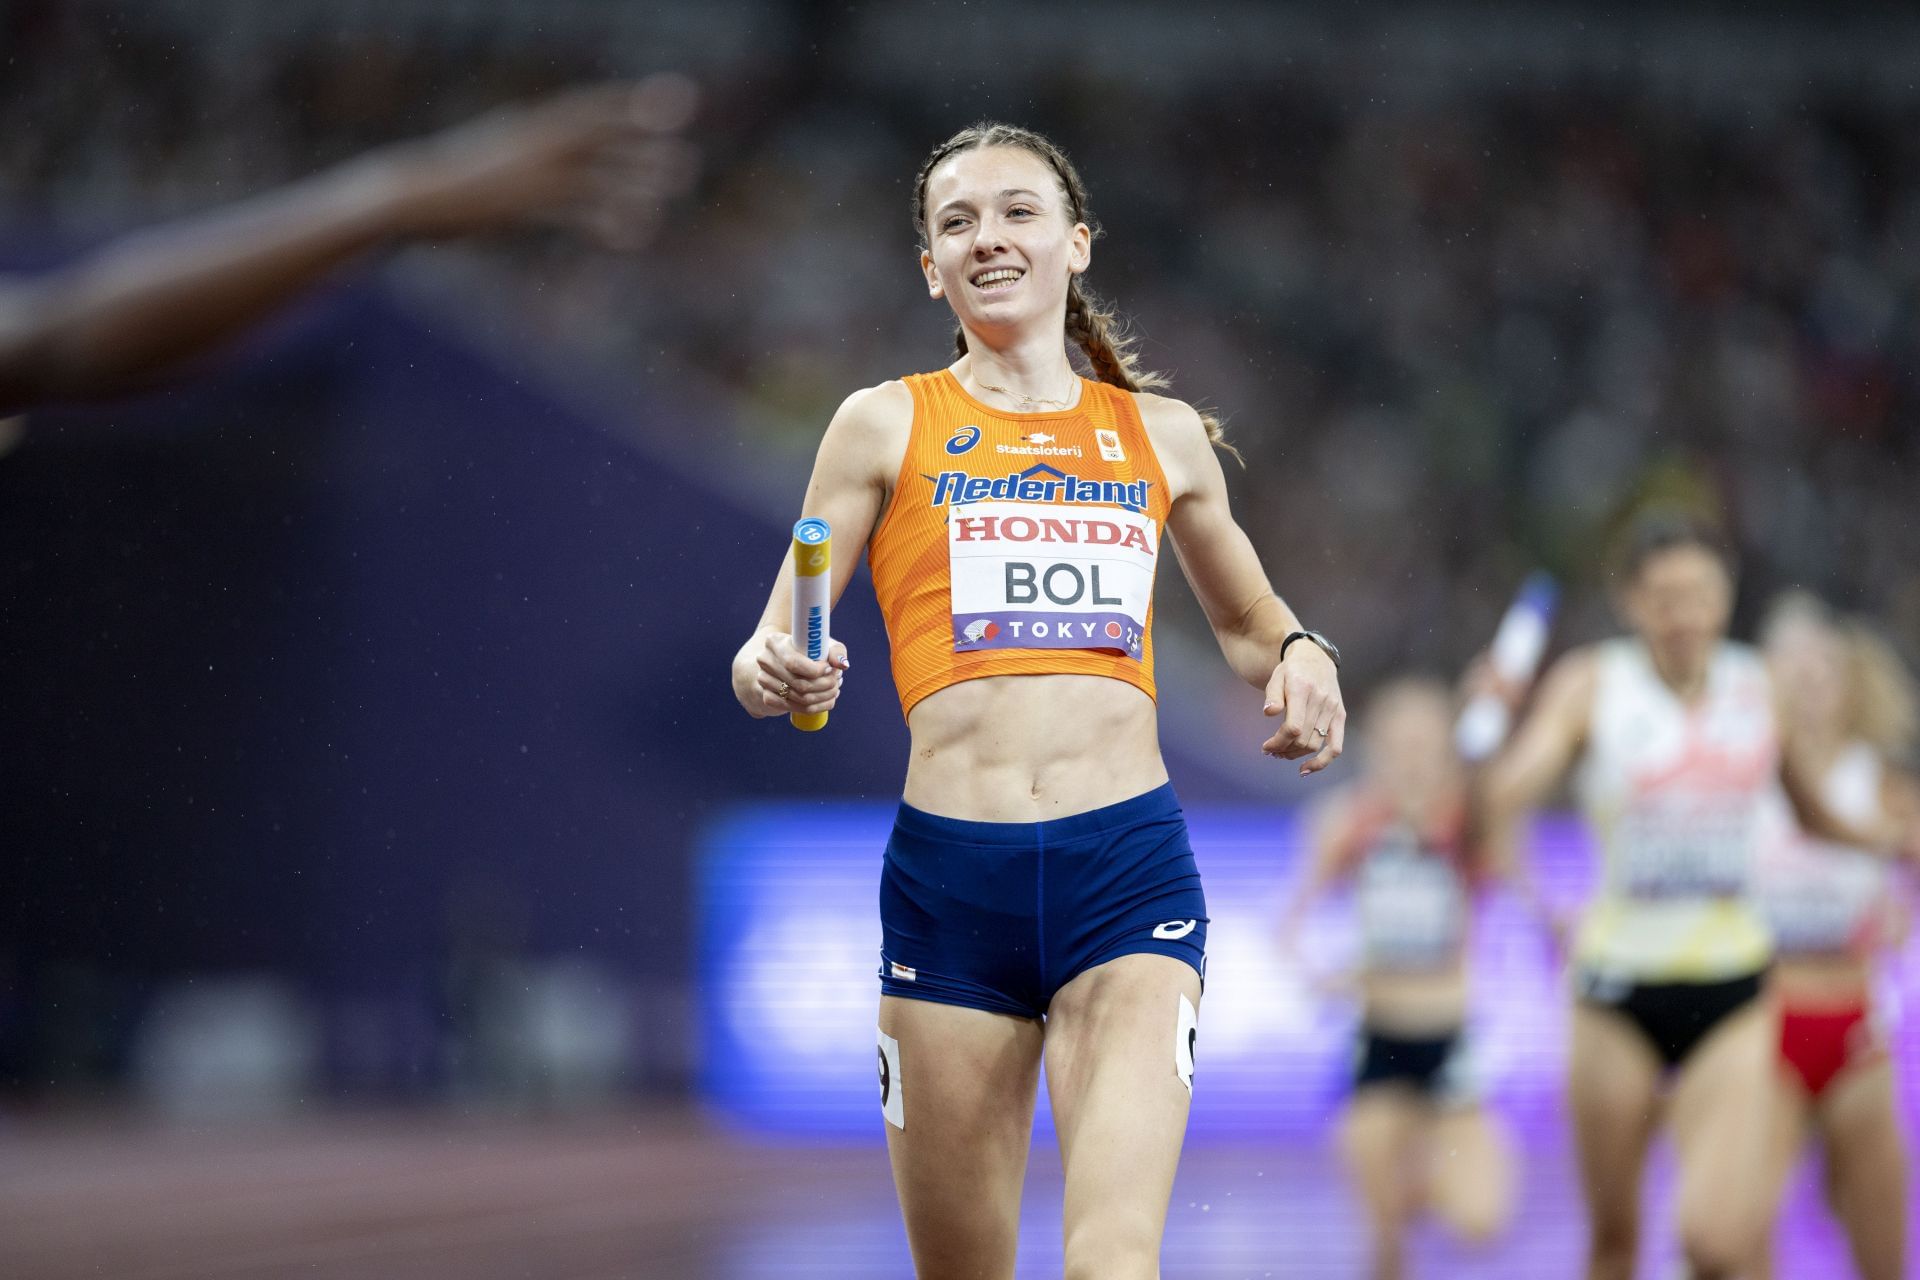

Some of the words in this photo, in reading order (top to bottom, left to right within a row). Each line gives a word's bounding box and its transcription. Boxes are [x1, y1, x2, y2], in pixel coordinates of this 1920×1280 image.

[996, 444, 1083, 459] Staatsloterij
[931, 470, 1148, 510] Nederland
[955, 516, 1154, 556] HONDA
[1005, 561, 1122, 606] BOL
[807, 615, 822, 661] MOND
